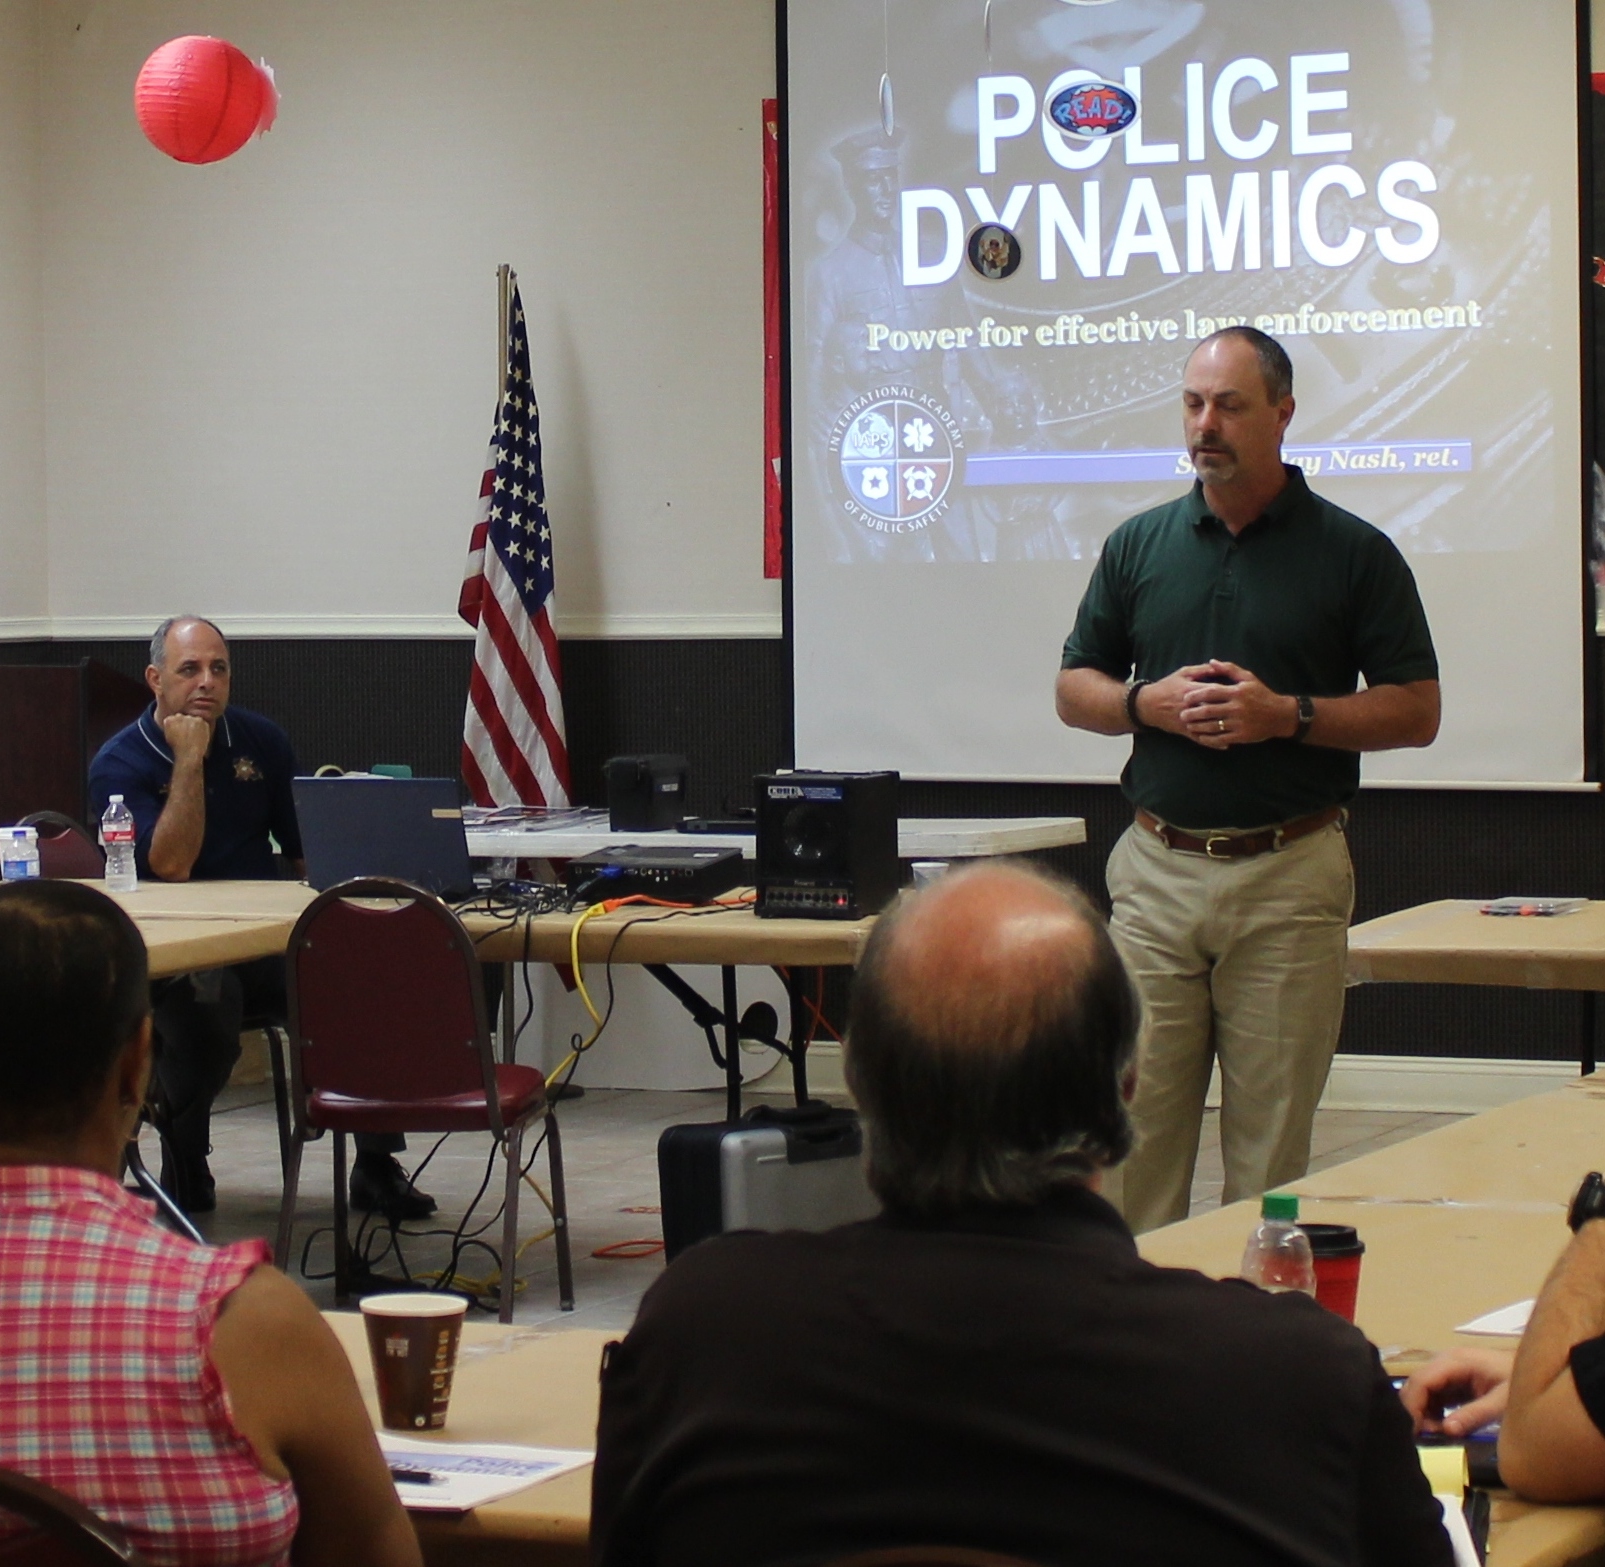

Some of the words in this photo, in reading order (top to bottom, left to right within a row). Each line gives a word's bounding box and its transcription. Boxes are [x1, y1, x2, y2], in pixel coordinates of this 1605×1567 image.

[976, 52, 1353, 174] POLICE
[1054, 96, 1132, 124] READ!
[900, 160, 1440, 287] DYNAMICS
[866, 322, 974, 351] Power
[979, 316, 1029, 347] for
[1035, 310, 1179, 347] effective
[1255, 300, 1483, 335] enforcement
[829, 386, 915, 452] INTERNATIONAL
[919, 393, 965, 450] ACADEMY
[853, 431, 890, 448] IAPS
[1328, 446, 1407, 471] Nash,
[1413, 447, 1460, 468] ret.
[844, 499, 859, 516] OF
[859, 514, 905, 534] PUBLIC
[907, 499, 950, 532] SAFETY
